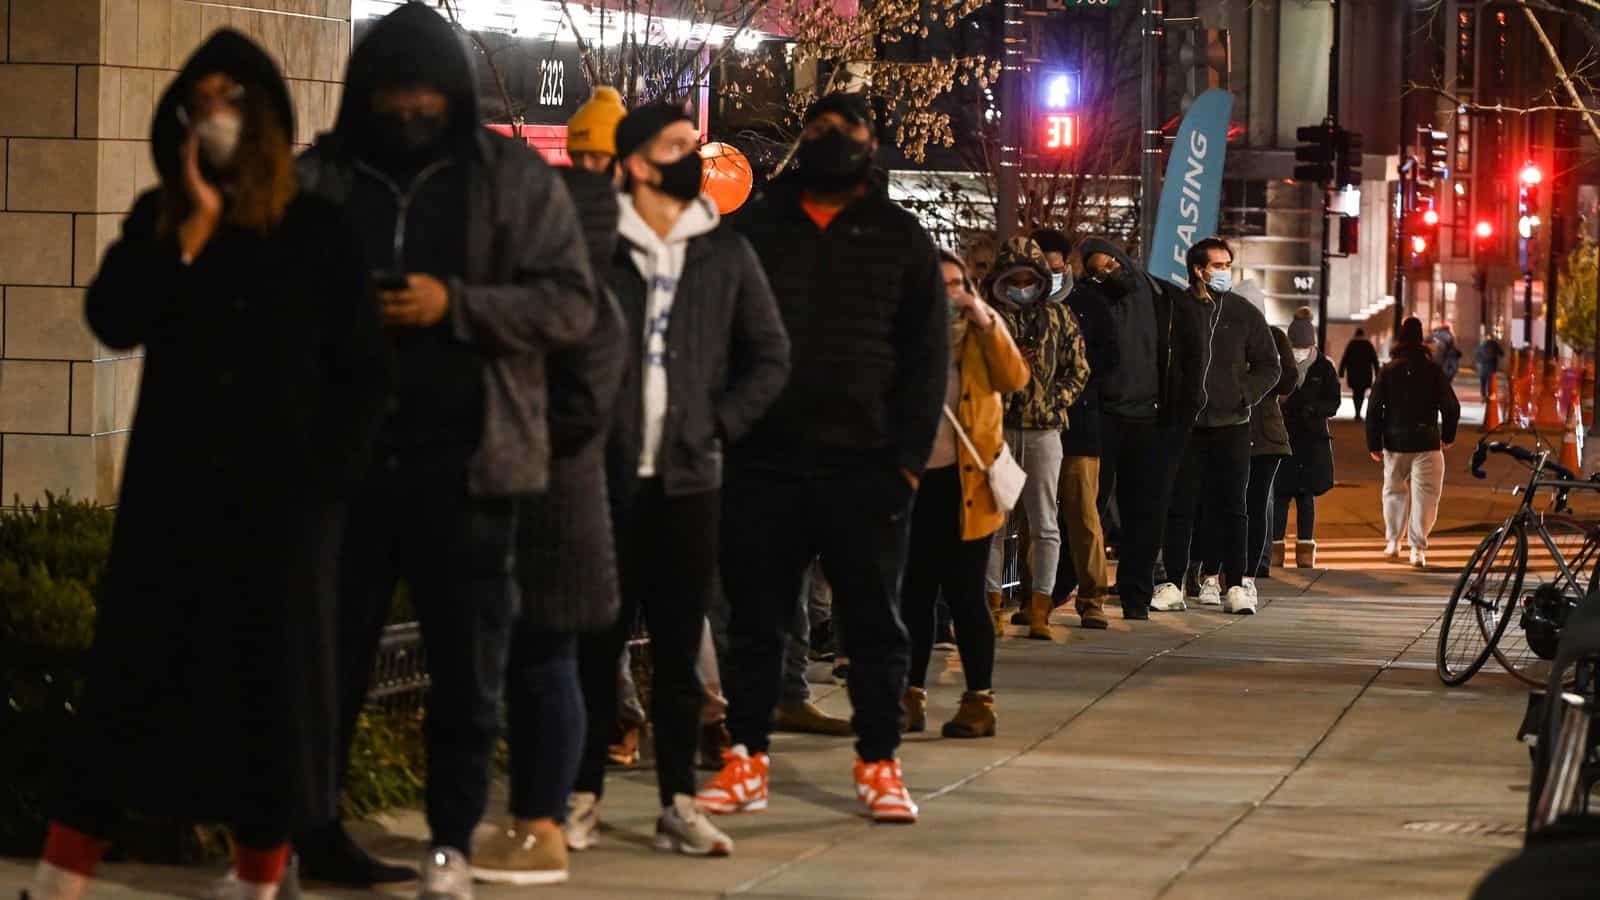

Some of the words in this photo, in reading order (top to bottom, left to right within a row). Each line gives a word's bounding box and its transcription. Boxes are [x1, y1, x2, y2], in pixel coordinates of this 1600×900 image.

[540, 58, 564, 106] 2323
[1047, 116, 1072, 148] 37
[1171, 129, 1208, 289] LEASING
[1294, 276, 1314, 289] 967
